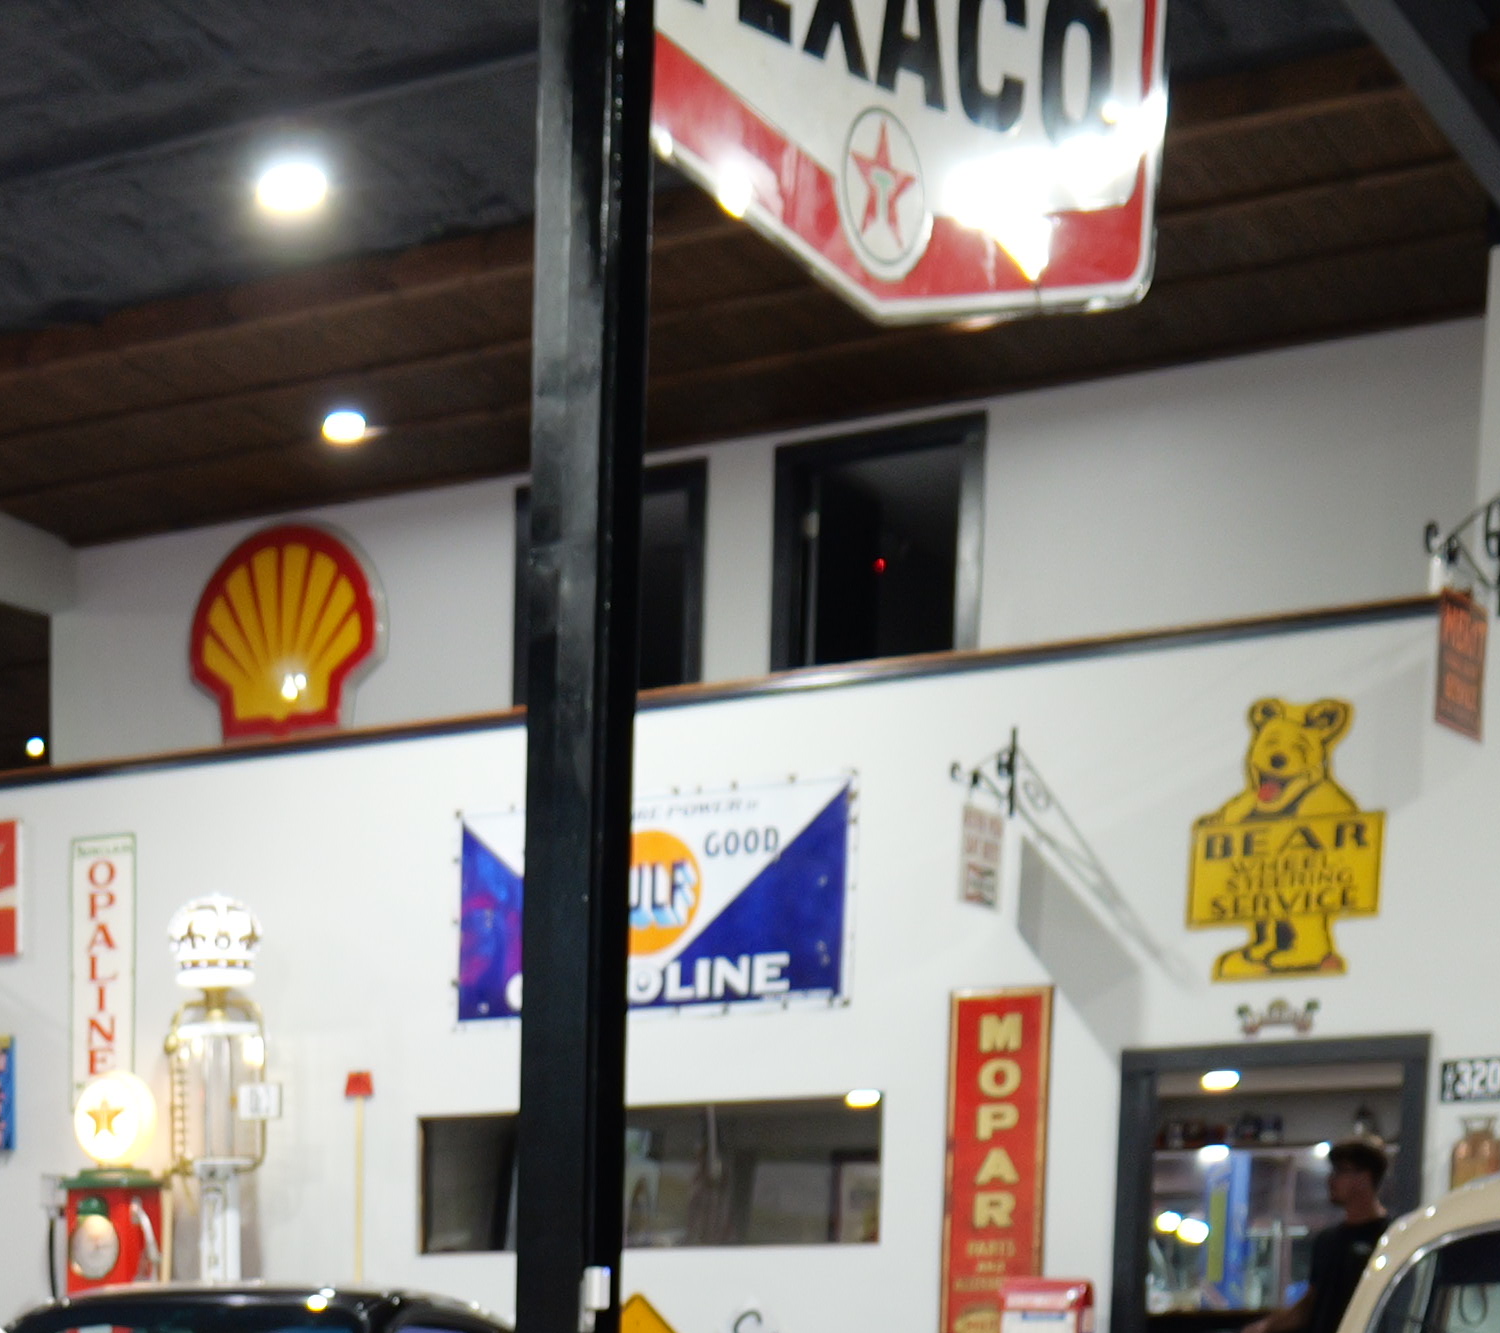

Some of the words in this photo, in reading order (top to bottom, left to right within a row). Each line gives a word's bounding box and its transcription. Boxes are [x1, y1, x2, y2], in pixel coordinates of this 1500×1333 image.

[704, 827, 780, 858] GOOD
[1205, 821, 1367, 861] BEAR
[628, 860, 698, 929] ULF
[1211, 886, 1355, 919] SERVICE
[88, 857, 118, 1077] OPALINE
[971, 1012, 1025, 1229] MOPAR
